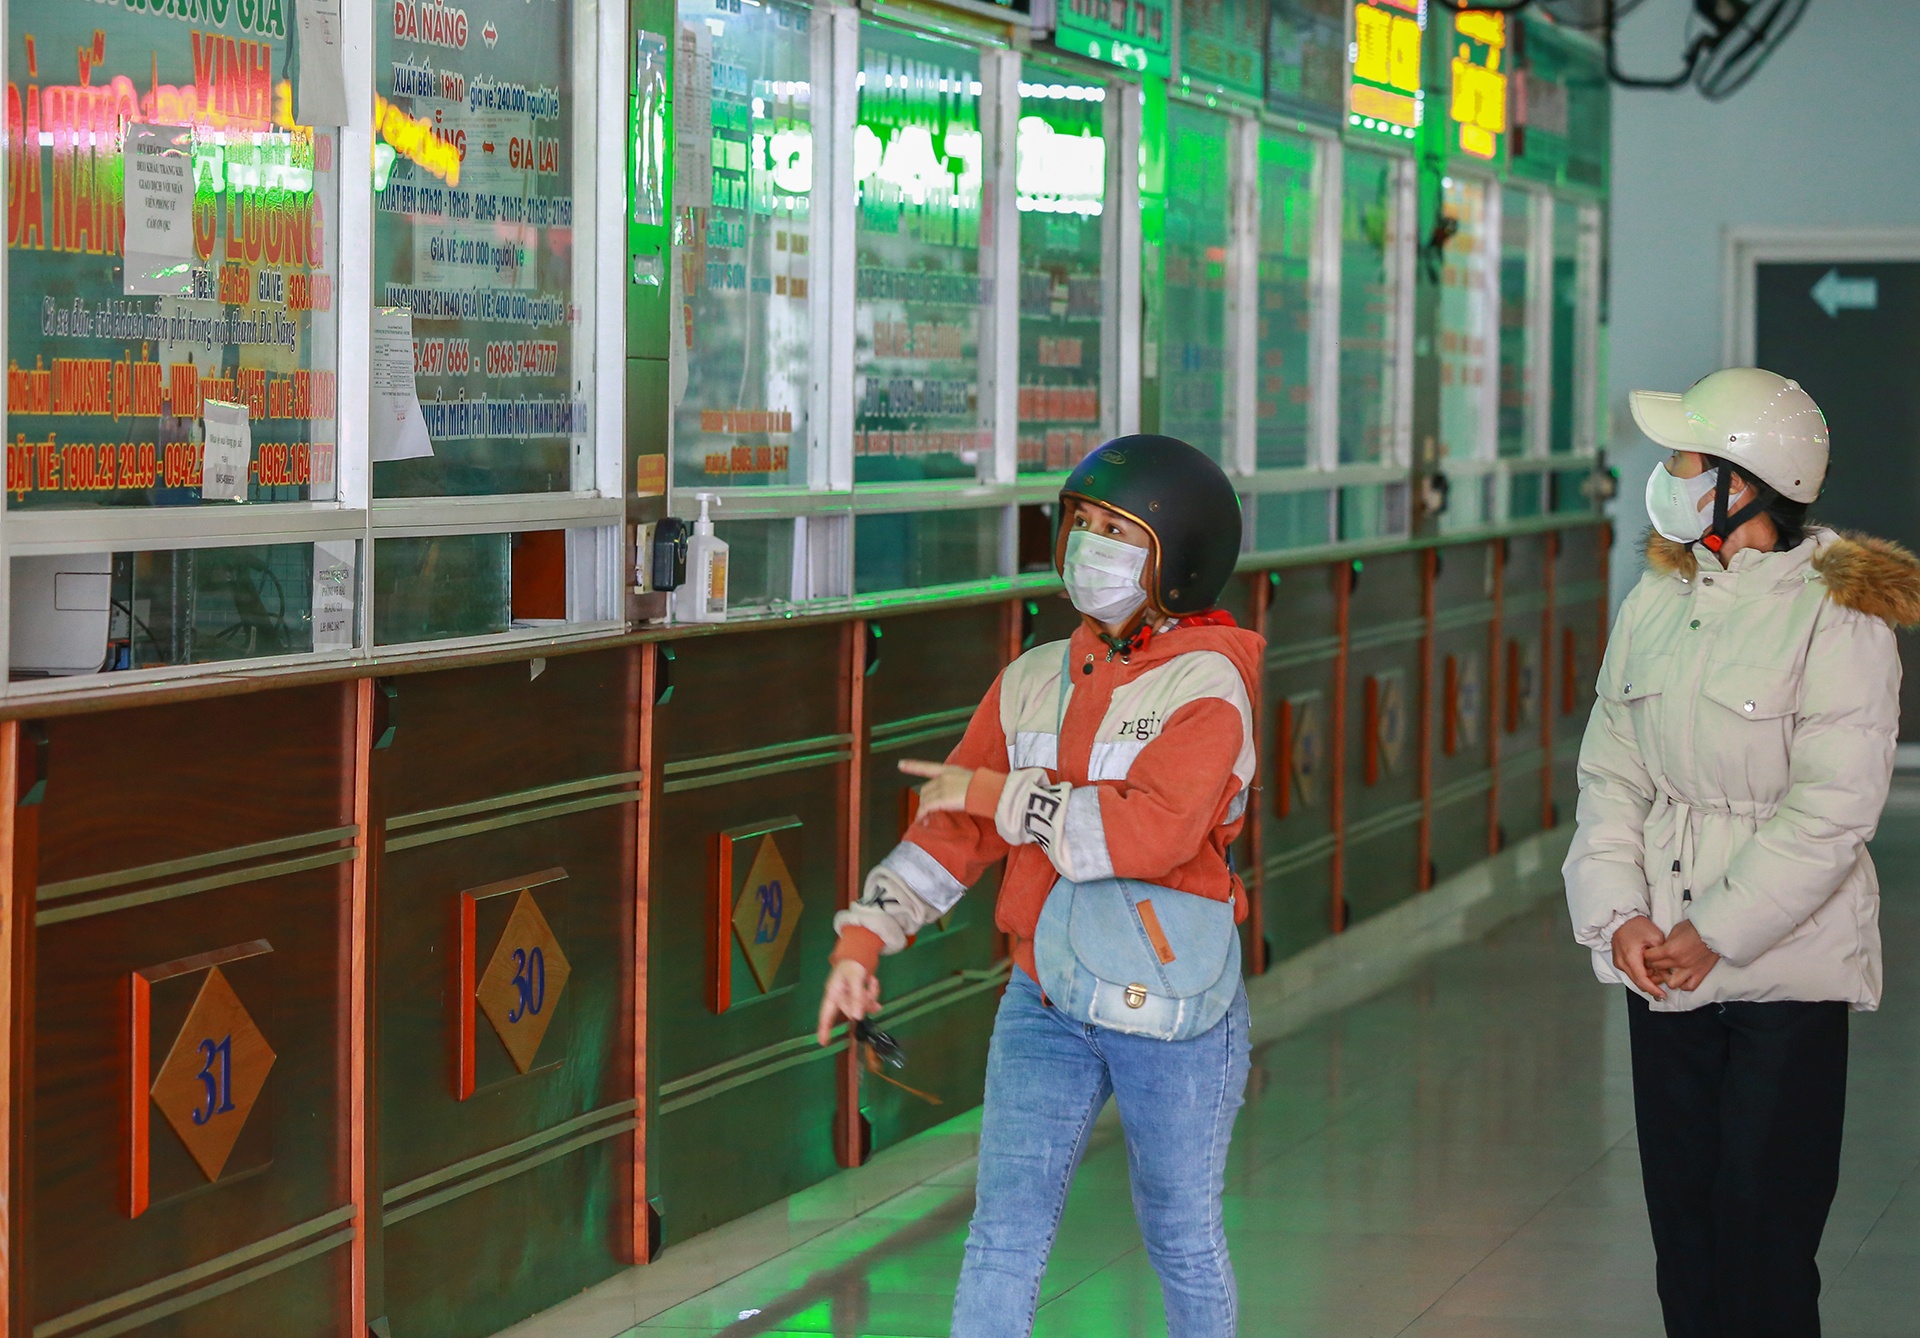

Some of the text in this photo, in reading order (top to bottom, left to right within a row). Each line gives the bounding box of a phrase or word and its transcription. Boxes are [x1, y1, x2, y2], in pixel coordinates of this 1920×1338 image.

[191, 29, 272, 122] VINH
[393, 52, 416, 95] XUẤT
[440, 69, 464, 103] 19h10
[497, 82, 526, 113] 240.000
[509, 136, 535, 170] GIA
[538, 137, 559, 173] LAI
[420, 187, 443, 216] 07h30
[449, 190, 470, 218] 19h30
[475, 193, 496, 221] 20h45
[501, 196, 523, 223] 21h15
[527, 198, 547, 225] 21h30
[446, 231, 459, 264] VÉ:
[460, 240, 475, 264] 200
[475, 242, 490, 266] 000
[170, 305, 187, 349] phí
[188, 312, 212, 351] trong
[231, 307, 257, 346] thành
[385, 286, 432, 315] LIMOUSINE
[433, 289, 460, 317] 21H40
[461, 285, 478, 318] GIÁ
[480, 285, 494, 318] VÉ:
[494, 292, 510, 319] 400
[511, 293, 527, 320] 000
[413, 342, 444, 374] 5.497
[447, 341, 469, 374] 666
[52, 358, 112, 415] LIMOUSINE
[449, 387, 470, 436] MIỄN
[472, 392, 486, 434] PHÍ
[487, 402, 513, 435] TRONG
[530, 393, 554, 434] THÀNH
[7, 433, 35, 502] ĐẶT
[37, 432, 61, 490] VÉ:
[118, 442, 156, 489] 29.99
[754, 879, 782, 945] 29
[508, 946, 546, 1024] 30
[192, 1033, 236, 1126] 31
